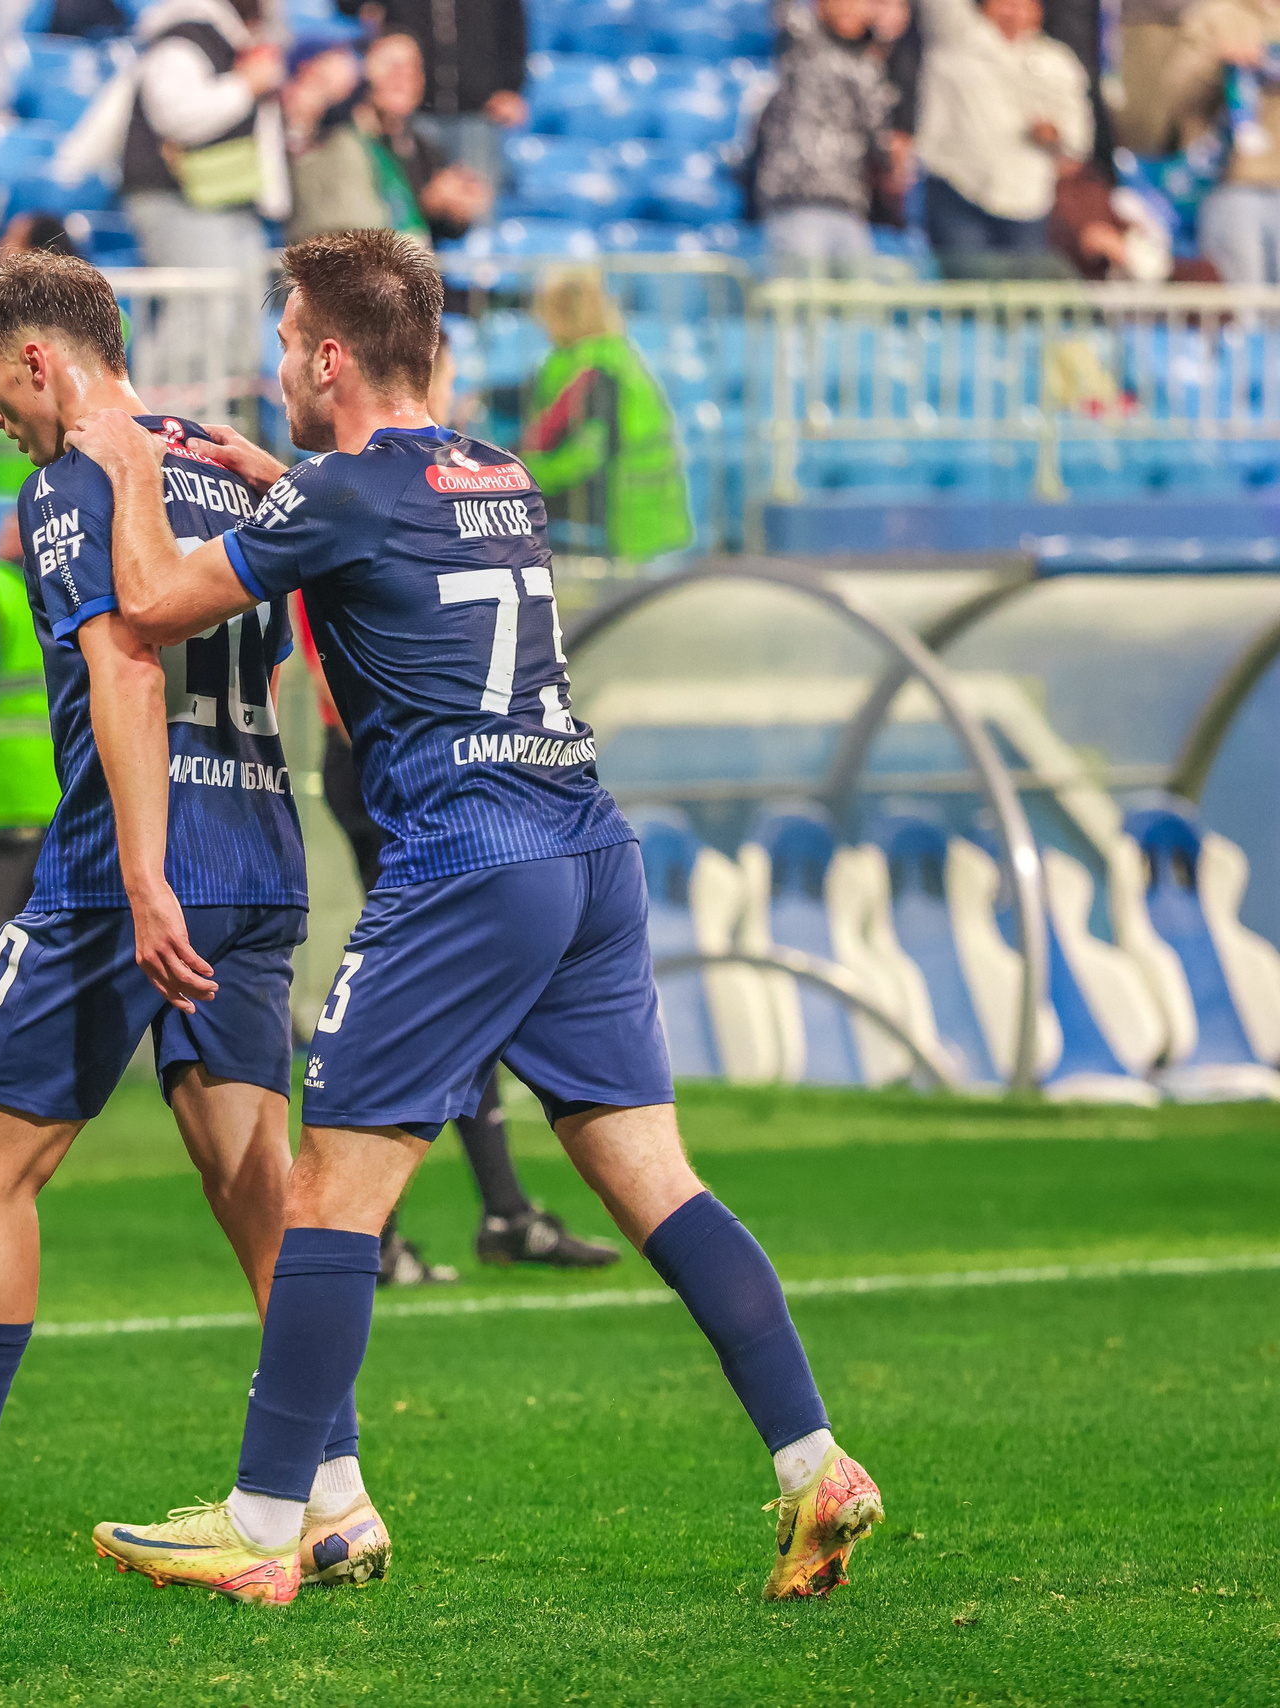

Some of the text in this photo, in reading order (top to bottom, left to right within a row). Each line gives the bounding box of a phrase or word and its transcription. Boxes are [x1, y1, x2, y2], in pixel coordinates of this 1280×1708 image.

[437, 474, 527, 491] СОЛИДАРНОСТЬ
[494, 465, 518, 475] БАНК
[255, 496, 289, 530] ET
[453, 499, 532, 539] ШИТОВ
[32, 507, 79, 554] FON
[39, 532, 85, 577] BET
[453, 734, 564, 767] САМАРСКАЯ
